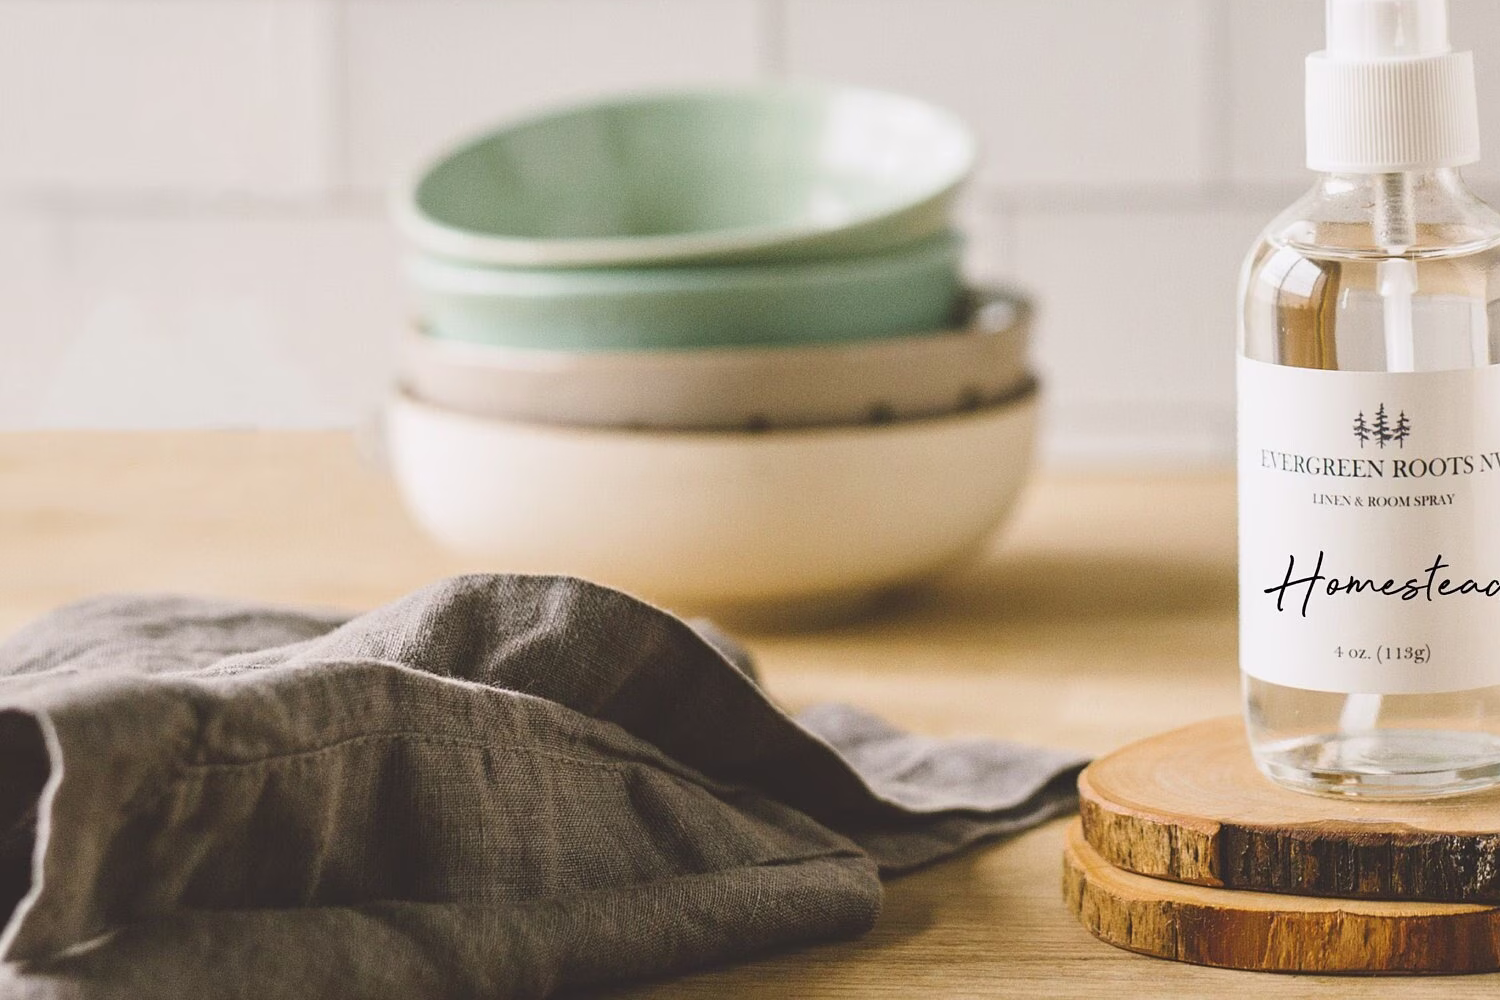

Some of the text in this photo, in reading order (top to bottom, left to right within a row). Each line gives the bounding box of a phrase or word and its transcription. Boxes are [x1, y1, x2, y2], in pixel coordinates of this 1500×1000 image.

[1260, 448, 1384, 478] EVERGREEN
[1392, 455, 1474, 478] ROOTS
[1312, 492, 1455, 508] LINEN & ROOM SPRAY
[1334, 644, 1432, 664] 4 oz. (113g)
